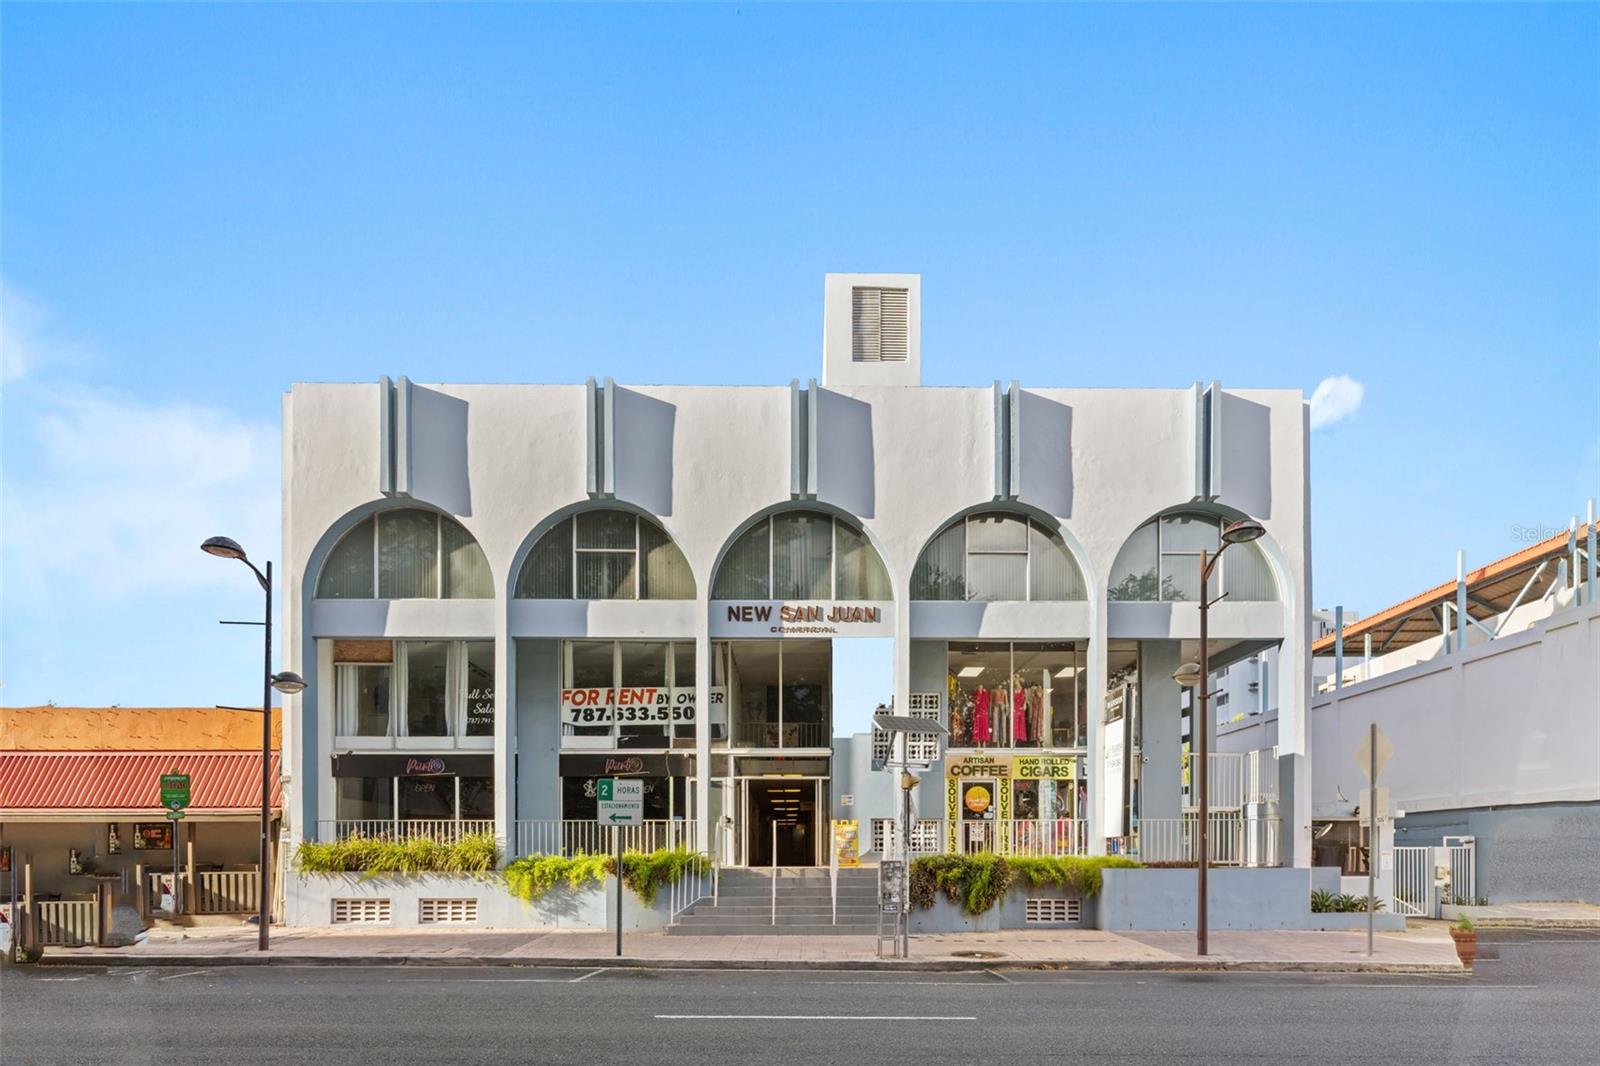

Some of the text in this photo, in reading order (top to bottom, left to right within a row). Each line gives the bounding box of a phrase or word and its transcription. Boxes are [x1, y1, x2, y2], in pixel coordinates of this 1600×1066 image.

[727, 606, 878, 623] NEW SAN JUAN
[562, 688, 724, 706] FOR RENT BY OWER
[571, 706, 696, 722] 787.633.550
[951, 765, 1008, 776] COFFEE
[1020, 766, 1069, 777] CIGARS
[601, 784, 640, 797] 2 HORAS
